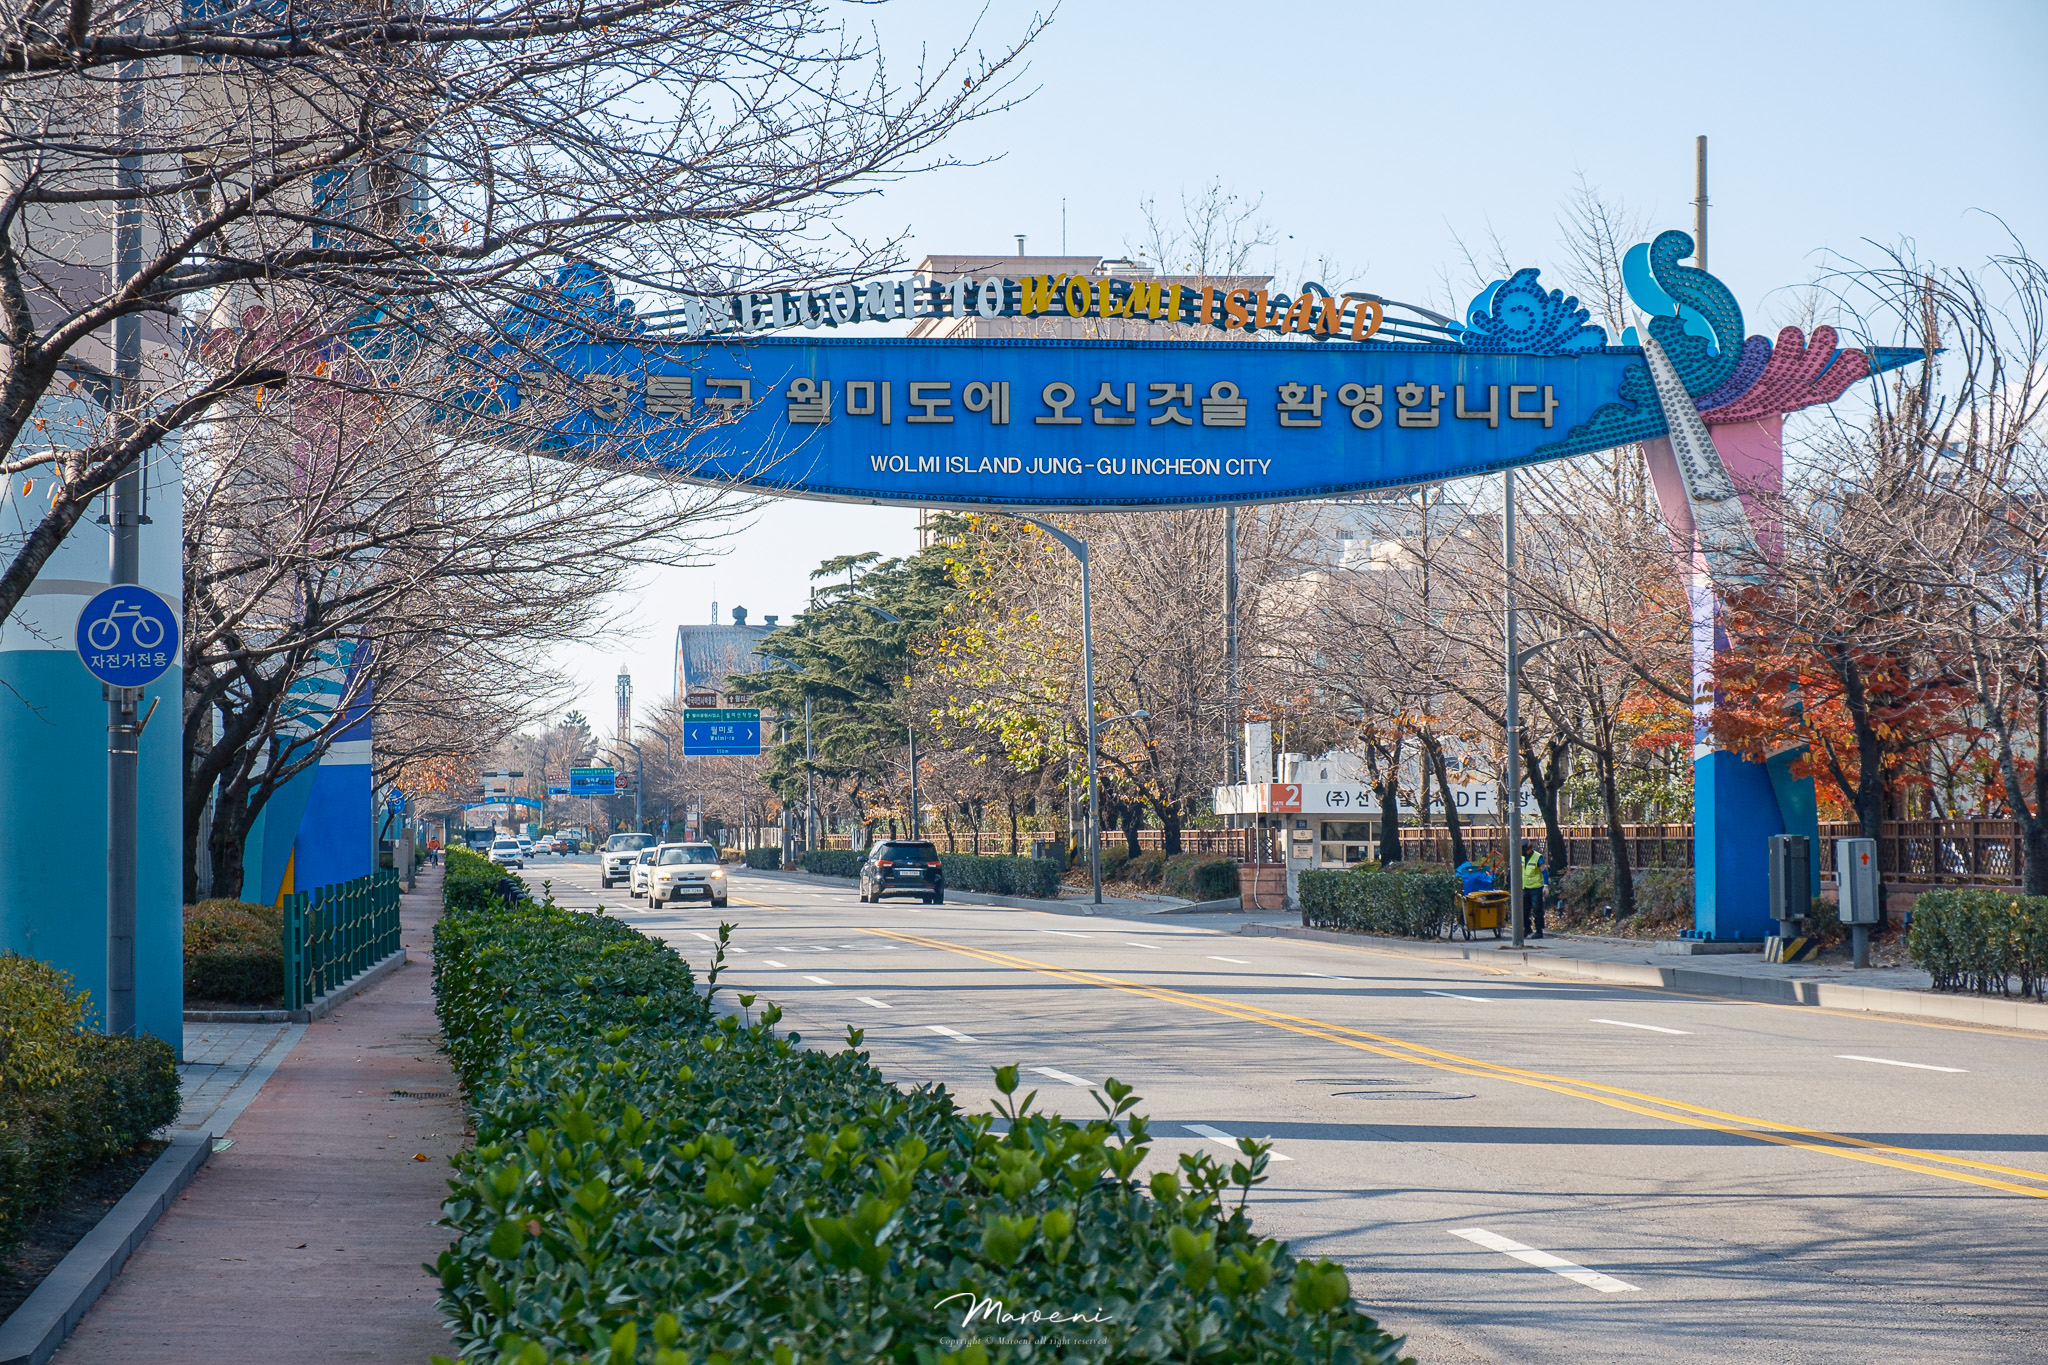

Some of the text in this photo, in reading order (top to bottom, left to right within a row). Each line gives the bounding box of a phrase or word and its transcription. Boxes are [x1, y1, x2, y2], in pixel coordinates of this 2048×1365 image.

[682, 268, 1384, 341] WELCOME TO WOLMI ISLAND
[786, 377, 1010, 426] 월미도에
[1035, 380, 1248, 428] 오신것을
[1276, 381, 1560, 431] 환영합니다
[870, 455, 1272, 475] WOLMI ISLAND JUNG-GU INCHEON CITY
[91, 652, 168, 669] 자전거전용
[711, 726, 734, 735] 월미로
[1285, 785, 1300, 806] 2
